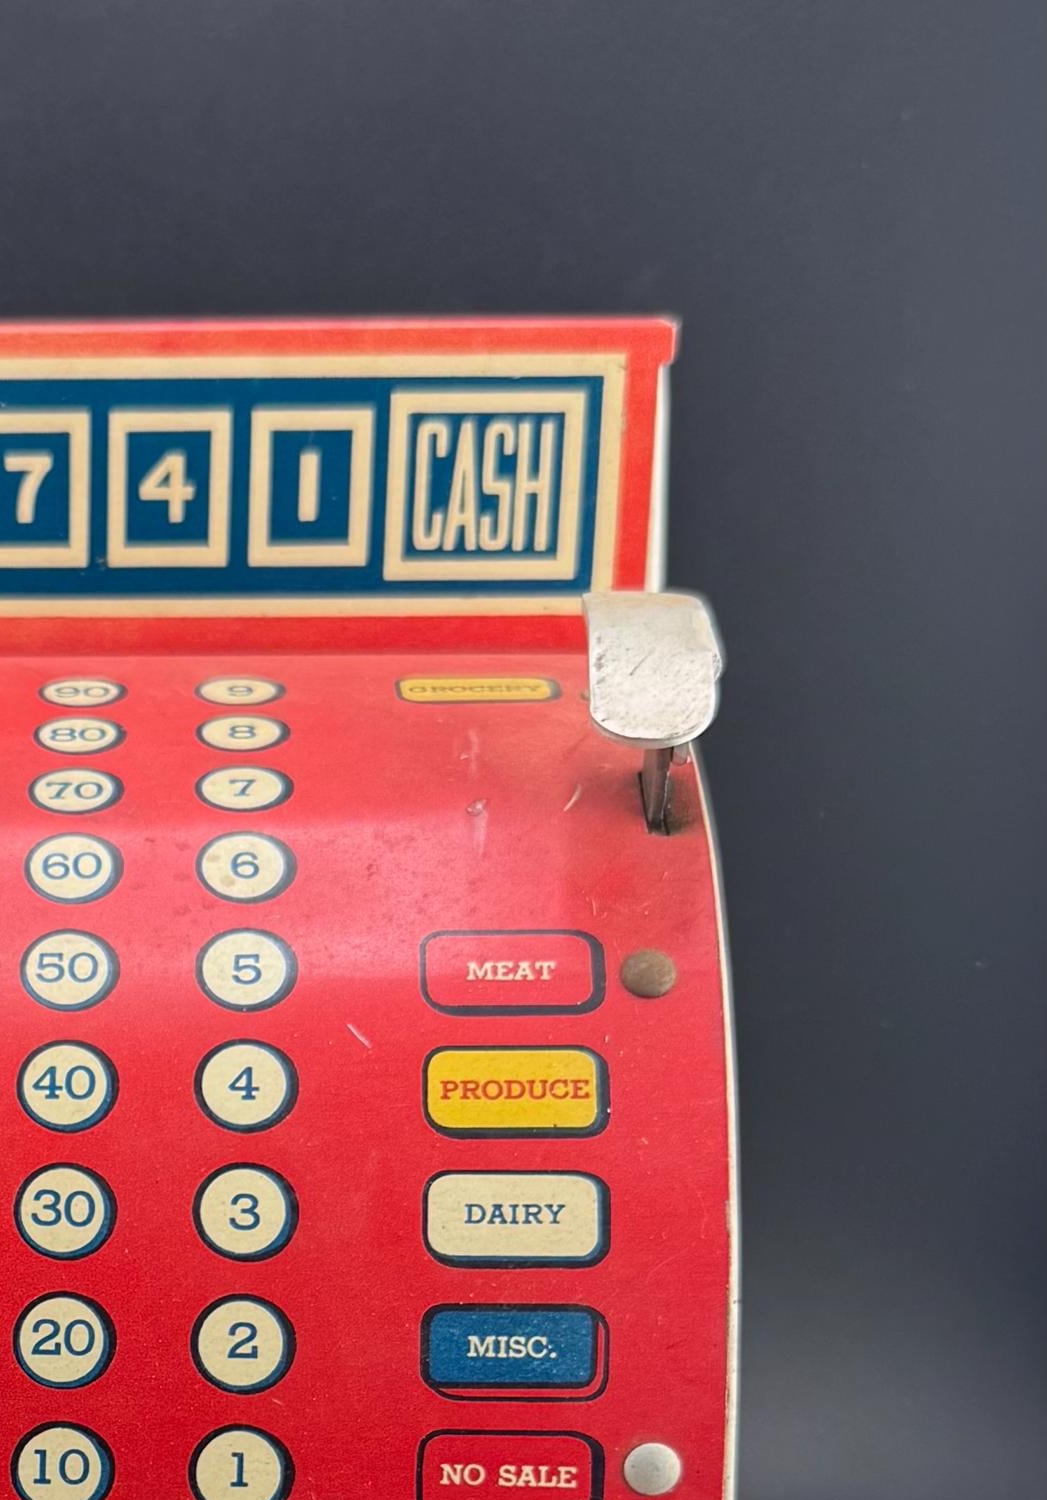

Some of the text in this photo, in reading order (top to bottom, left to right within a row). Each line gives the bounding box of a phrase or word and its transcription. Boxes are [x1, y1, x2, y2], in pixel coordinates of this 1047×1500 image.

[3, 454, 53, 524] 7
[139, 450, 196, 524] 4
[412, 419, 558, 552] CASH
[52, 686, 112, 699] 90
[227, 684, 255, 697] 9
[408, 684, 541, 695] GROCERY
[49, 727, 108, 743] 80
[228, 724, 256, 740] 8
[46, 782, 104, 800] 70
[229, 779, 256, 798] 7
[42, 853, 103, 881] 60
[230, 852, 260, 880] 6
[36, 953, 99, 983] 50
[232, 954, 263, 985] 5
[466, 960, 556, 982] MEAT
[32, 1066, 97, 1100] 40
[228, 1067, 260, 1101] 4
[440, 1079, 590, 1101] PRODUCE
[30, 1189, 97, 1227] 30
[228, 1193, 261, 1231] 3
[464, 1203, 567, 1226] DAIRY
[31, 1319, 96, 1356] 20
[227, 1323, 259, 1359] 2
[467, 1335, 558, 1359] MISC.
[33, 1449, 90, 1486] 10
[230, 1452, 248, 1488] 1
[439, 1463, 577, 1489] NO SALE
